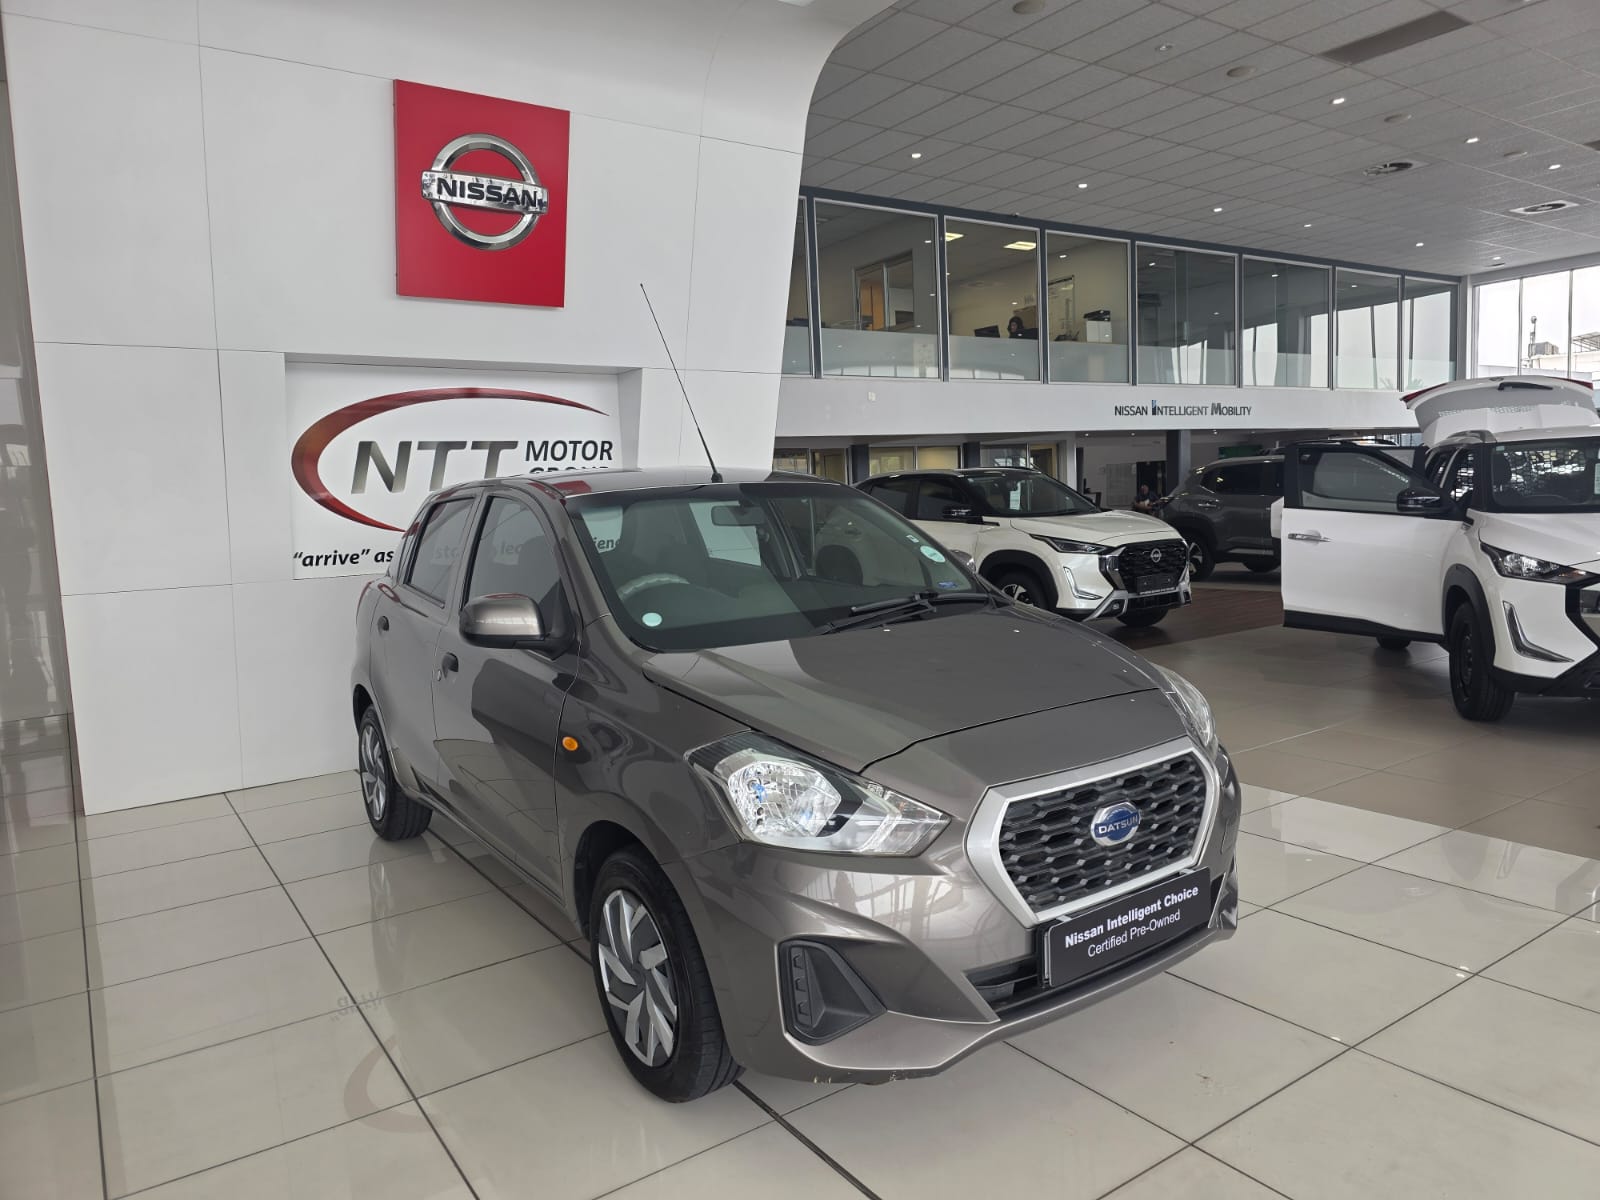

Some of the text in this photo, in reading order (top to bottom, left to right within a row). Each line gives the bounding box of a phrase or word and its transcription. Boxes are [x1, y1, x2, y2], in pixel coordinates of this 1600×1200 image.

[437, 178, 538, 207] NISSAN
[1114, 405, 1148, 416] NISSAN
[525, 440, 613, 461] MOTOR
[351, 440, 519, 494] NTT
[374, 551, 394, 563] as
[1098, 814, 1138, 834] DATSUN
[1065, 886, 1199, 948] Nissan Intelligent Choice
[1087, 909, 1181, 958] Certified Pre-Owned
